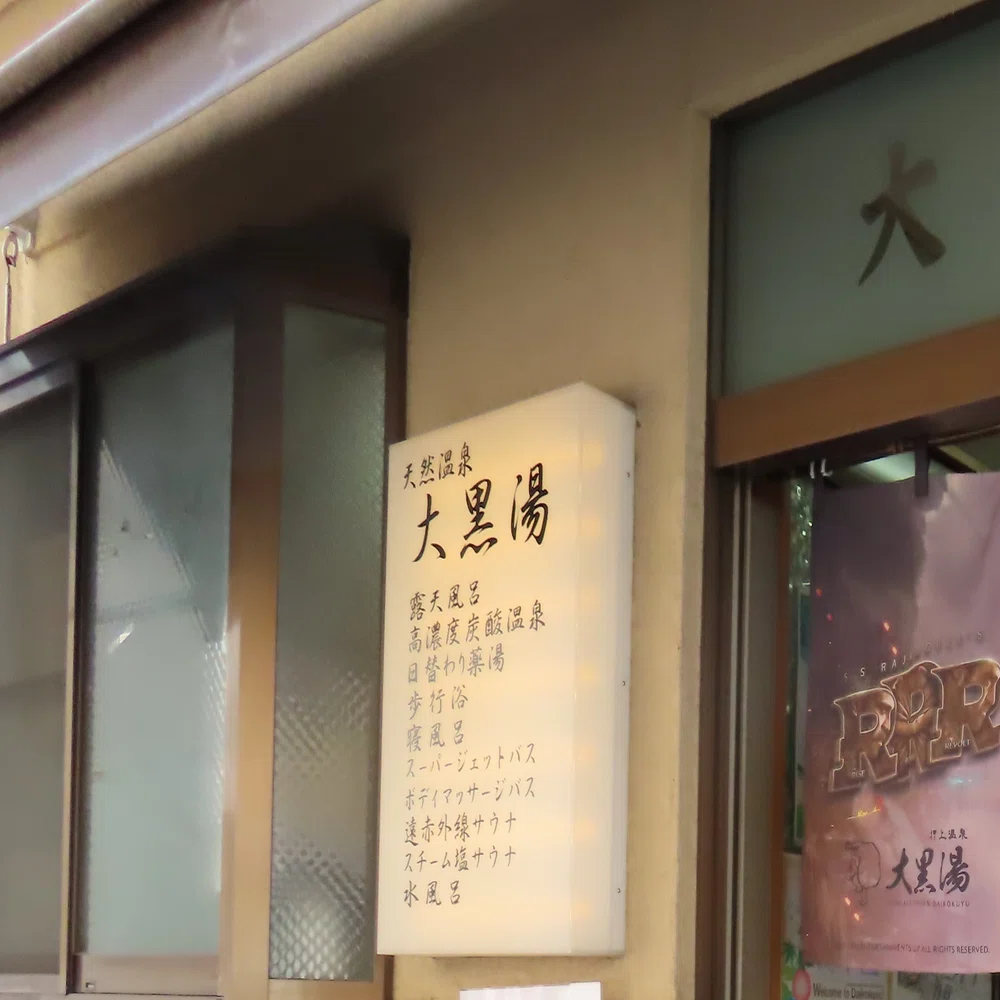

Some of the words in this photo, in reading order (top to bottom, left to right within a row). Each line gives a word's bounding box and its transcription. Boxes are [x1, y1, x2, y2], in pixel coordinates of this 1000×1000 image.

[403, 442, 473, 490] 天然温泉
[412, 462, 549, 562] 大黒湯
[409, 580, 480, 621] 露天風呂
[408, 599, 546, 653] 高濃度炭酸温泉
[407, 643, 506, 684] 日替わり薬湯
[407, 684, 469, 720] 歩行浴
[406, 719, 465, 753] 寝風呂
[405, 743, 536, 778] スーパージェットバス
[404, 811, 517, 847] 遠赤外線サウナ
[404, 845, 517, 873] スチーム塩サウナ
[885, 845, 971, 895] 大黒湯
[403, 880, 462, 908] 水風呂
[932, 945, 956, 954] RIGHTS
[956, 946, 990, 955] RESERVED.
[812, 983, 842, 999] Welcome
[843, 986, 850, 998] to
